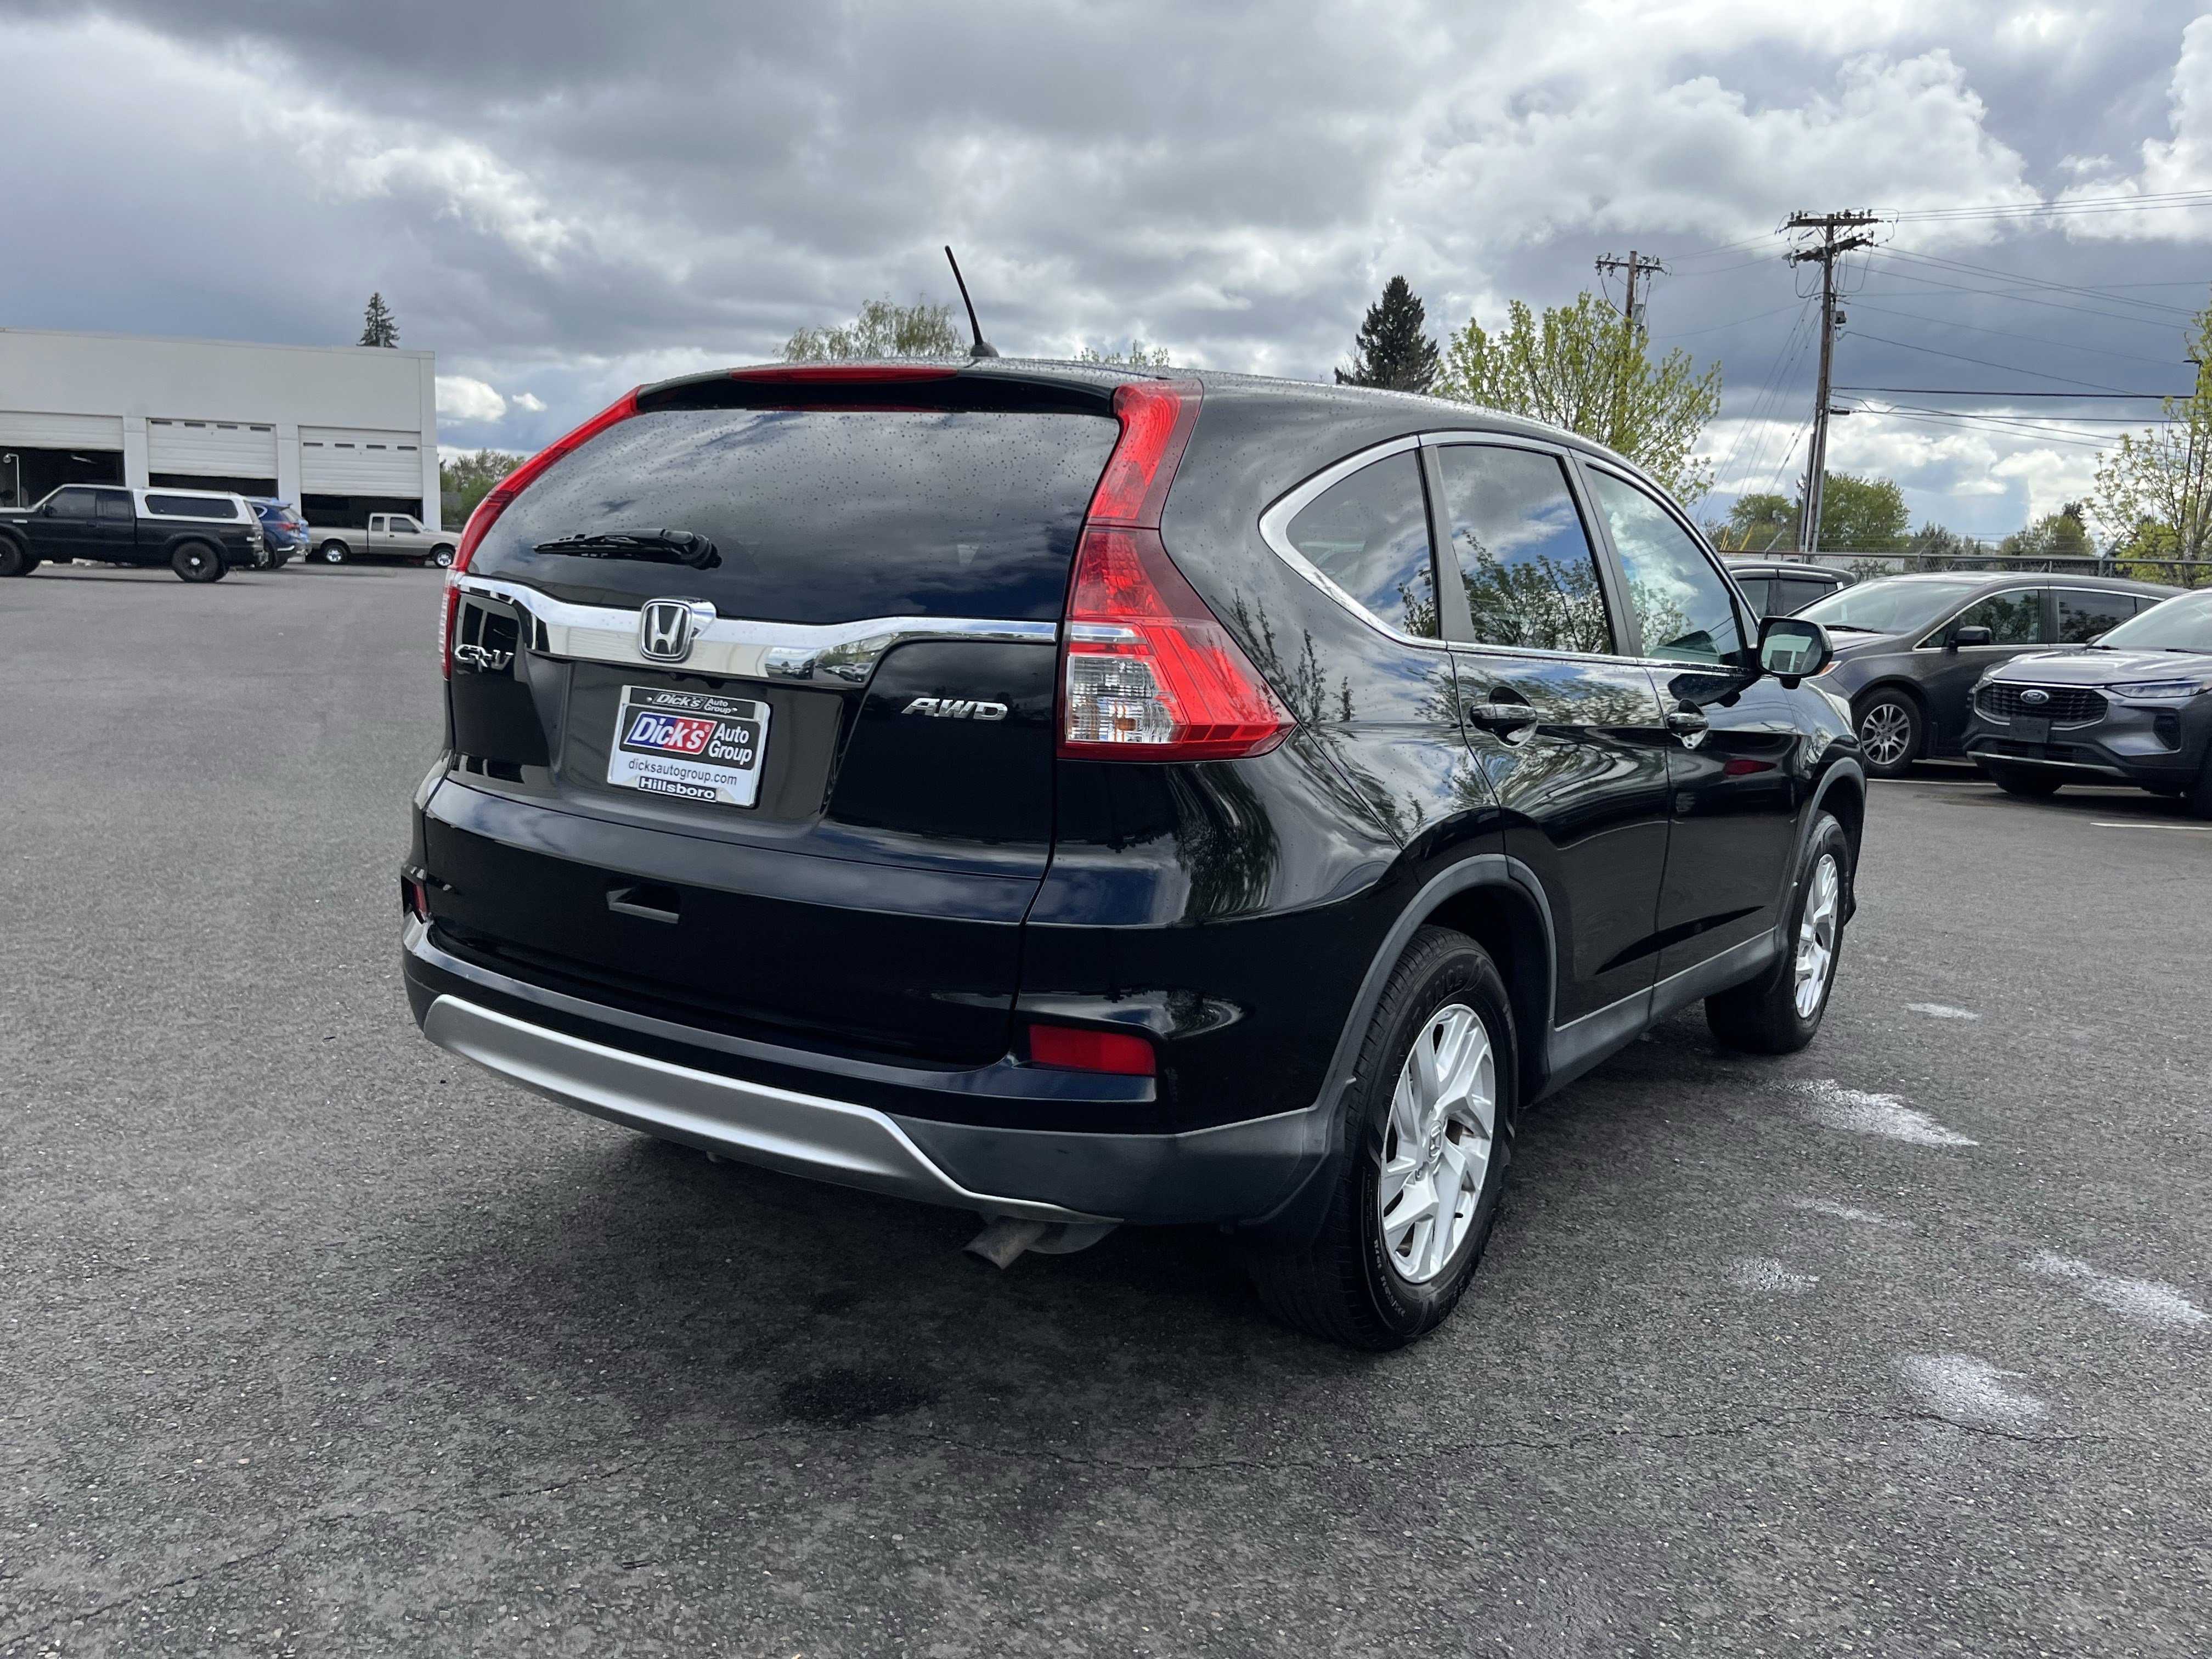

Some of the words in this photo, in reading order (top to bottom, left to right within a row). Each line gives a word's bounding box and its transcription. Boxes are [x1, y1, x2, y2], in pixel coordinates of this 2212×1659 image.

[704, 704, 731, 714] Group
[707, 698, 729, 707] Auto
[901, 697, 1008, 720] AWD
[713, 723, 749, 744] Auto
[708, 740, 752, 765] Group
[628, 758, 737, 786] dicksautogroup.com
[640, 777, 715, 799] Hillsboro
